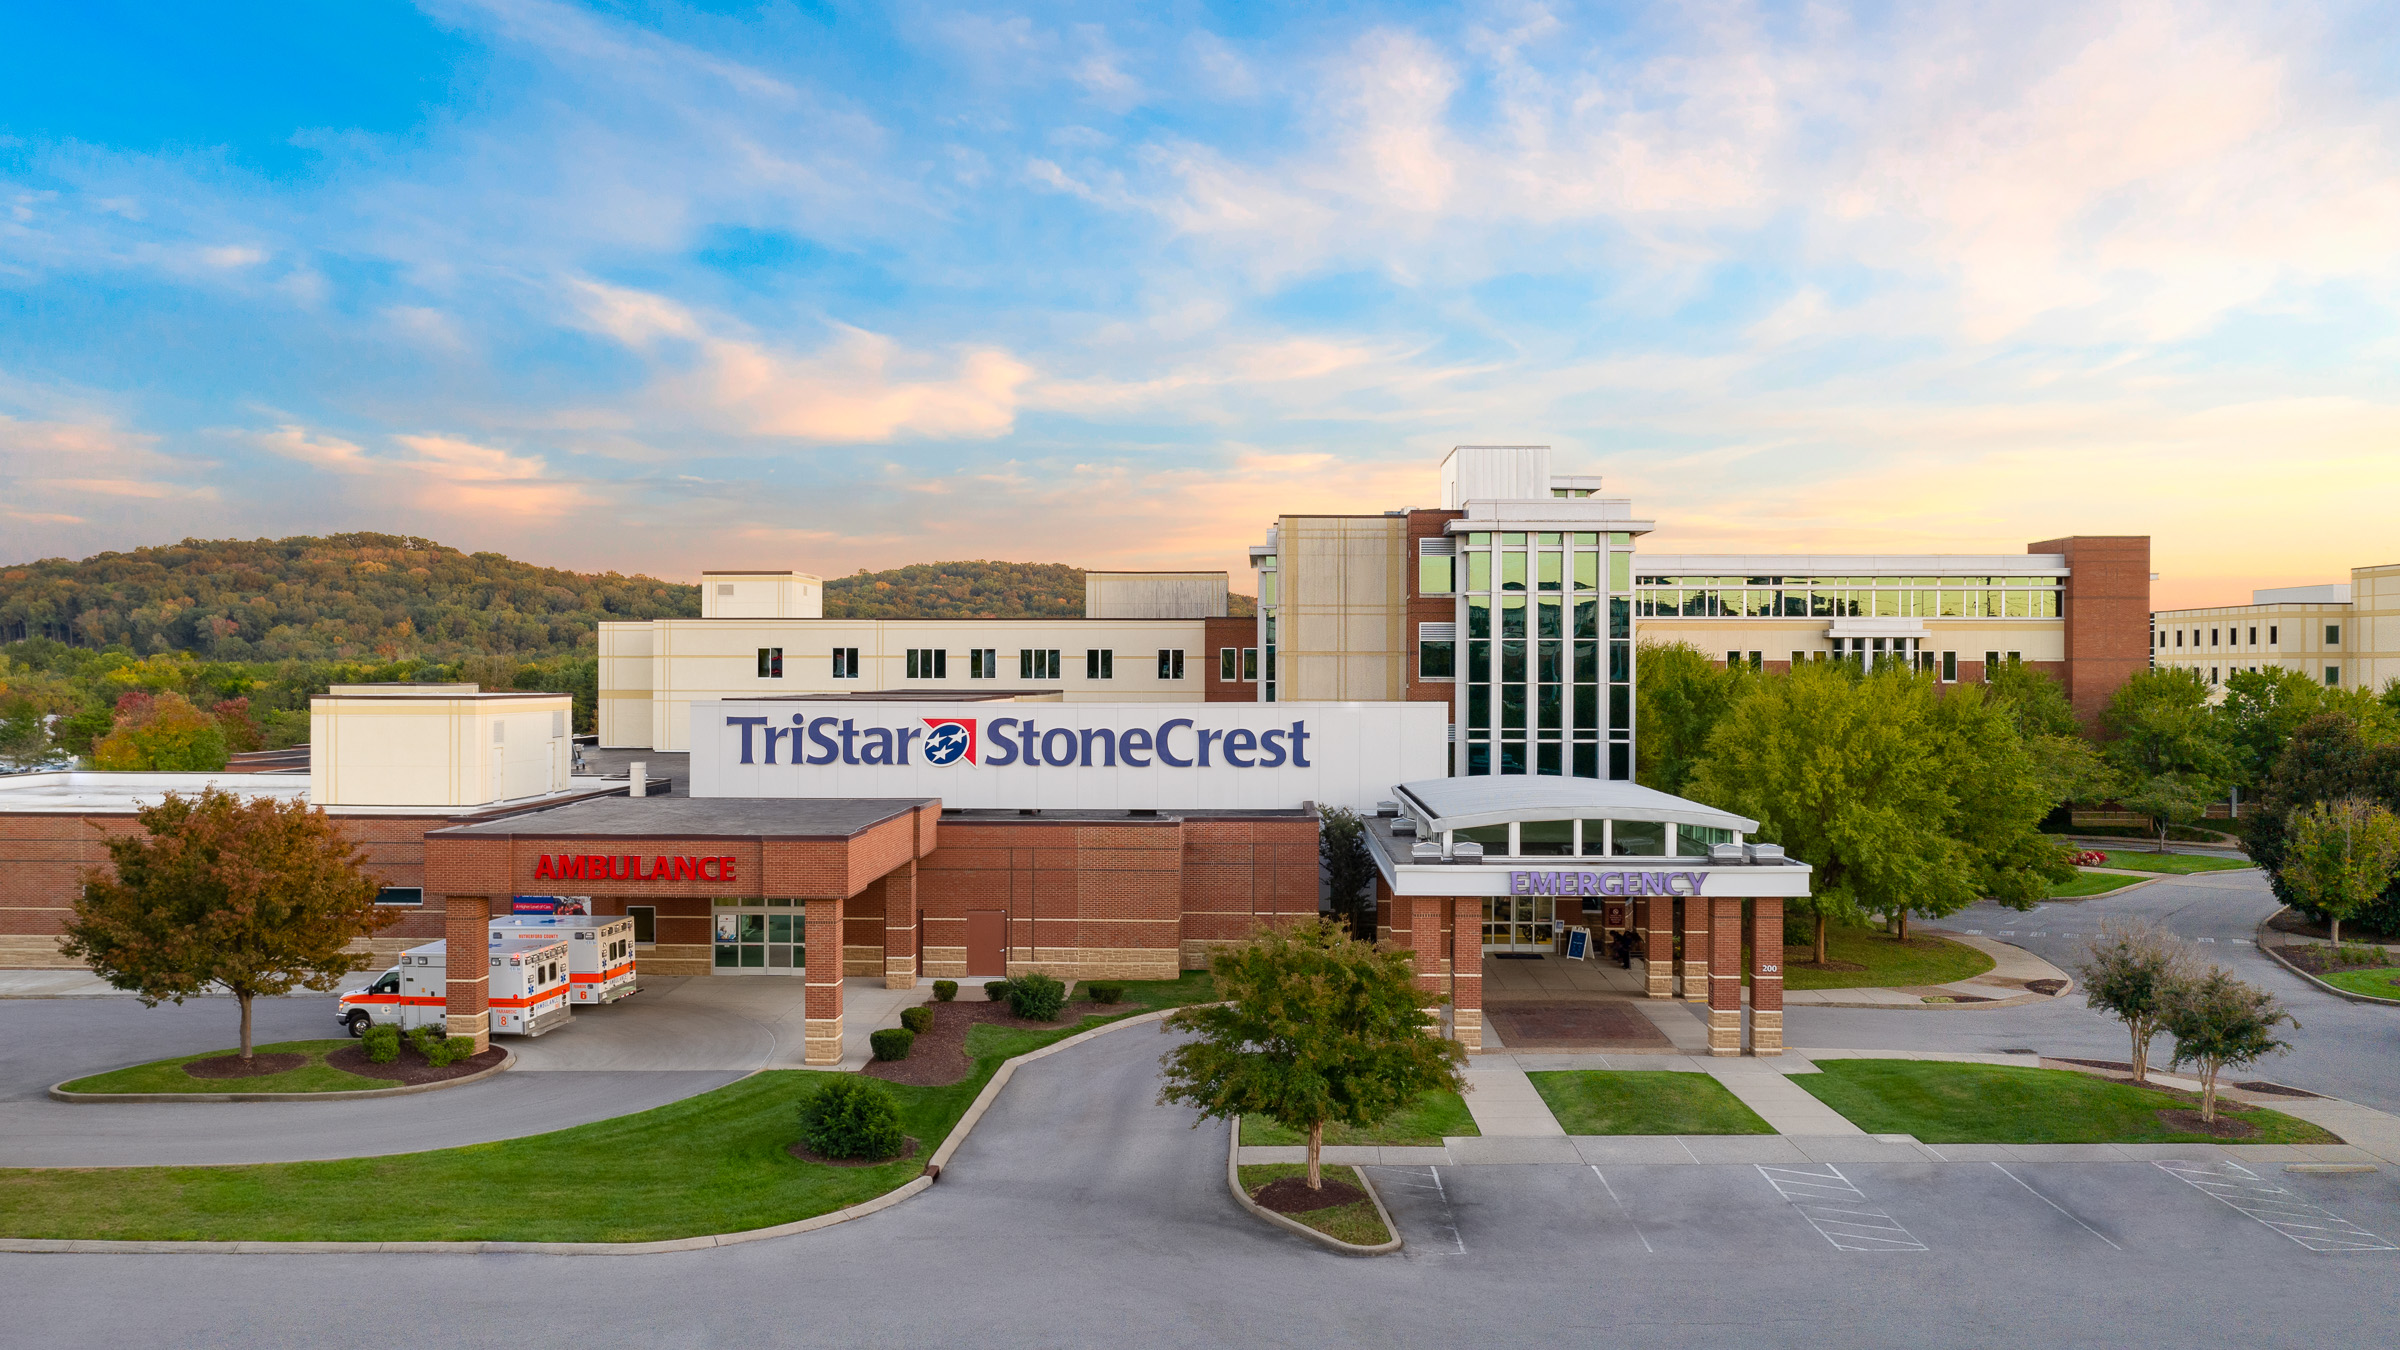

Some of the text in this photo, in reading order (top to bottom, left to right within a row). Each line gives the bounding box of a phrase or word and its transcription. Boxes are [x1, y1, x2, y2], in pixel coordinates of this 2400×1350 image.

[727, 713, 1311, 768] TriStar StoneCrest
[534, 854, 737, 881] AMBULANCE
[1510, 871, 1710, 896] EMERGENCY
[1762, 964, 1778, 972] 200
[580, 991, 587, 1000] 6
[537, 997, 559, 1010] AMBULANCE
[501, 1016, 507, 1026] 8
